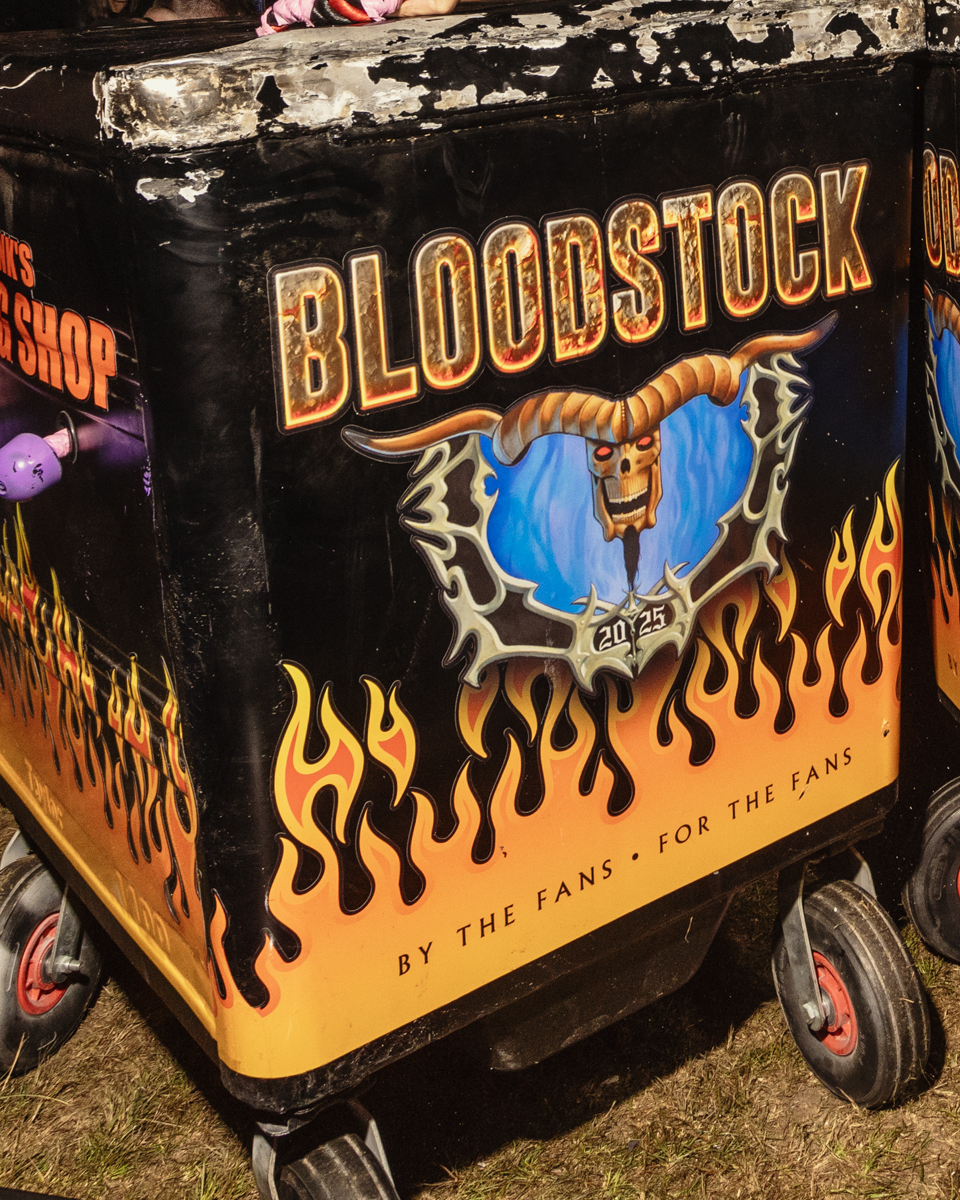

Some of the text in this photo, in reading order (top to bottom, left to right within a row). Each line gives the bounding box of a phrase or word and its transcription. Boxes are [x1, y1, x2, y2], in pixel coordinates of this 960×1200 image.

[14, 291, 116, 410] SHOP
[273, 162, 873, 429] BLOODSTOCK
[398, 747, 853, 977] BY THE FANS FOR THE FANS
